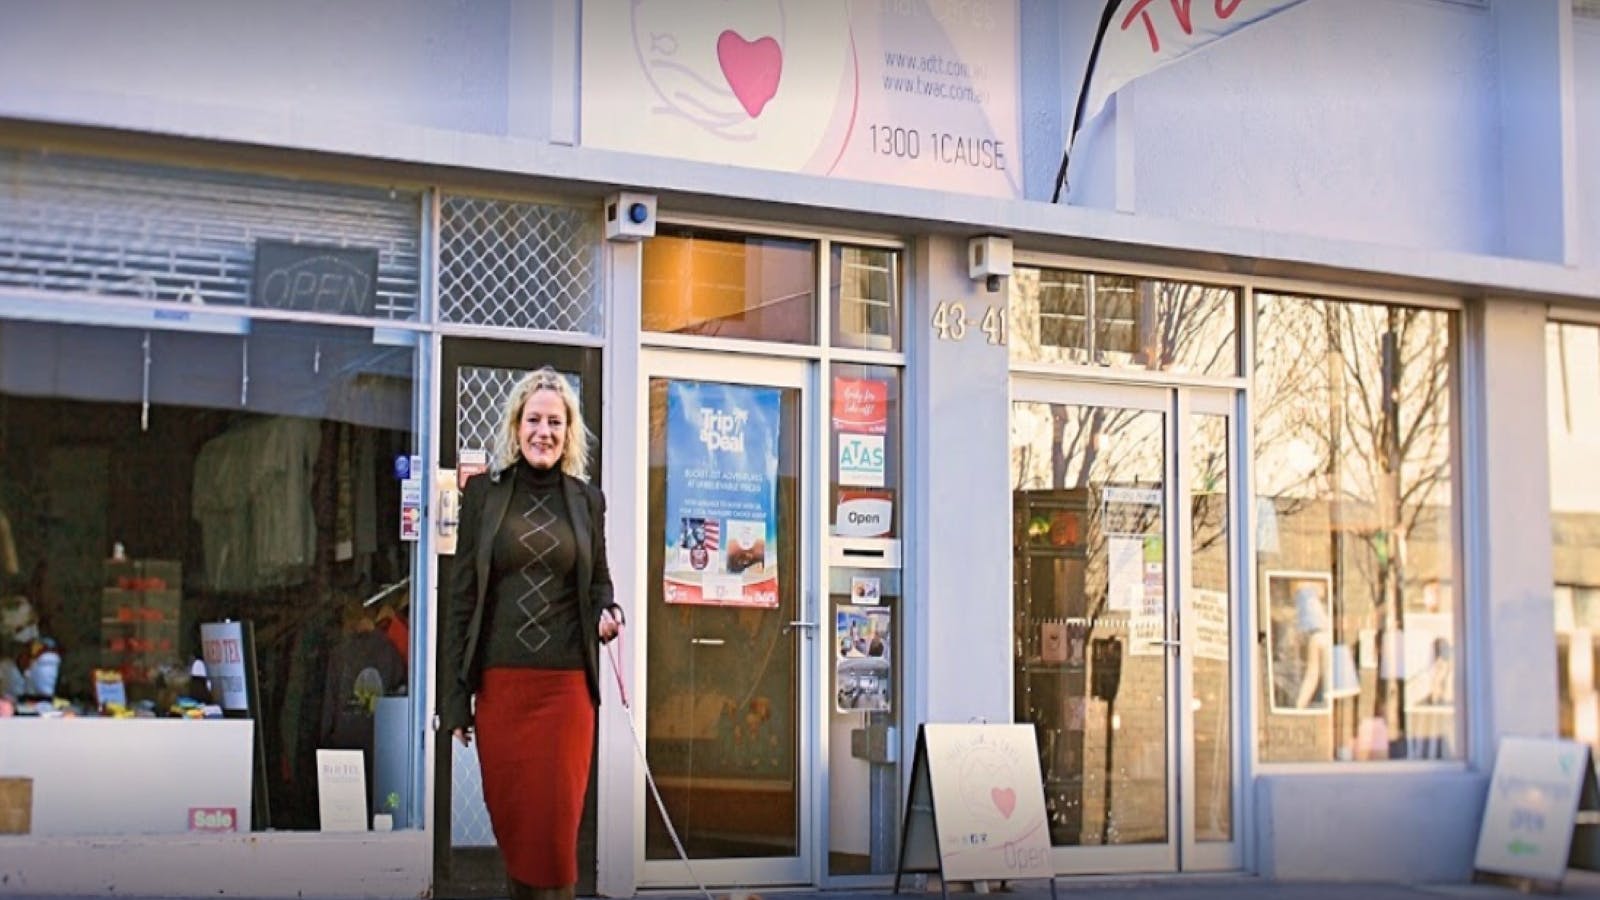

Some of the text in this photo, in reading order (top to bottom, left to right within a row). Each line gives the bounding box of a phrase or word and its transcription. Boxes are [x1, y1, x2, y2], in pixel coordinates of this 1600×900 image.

[869, 124, 1006, 171] 1300 1CAUSE
[263, 269, 371, 315] OPEN
[699, 406, 734, 435] Trip
[707, 431, 745, 453] Deal
[840, 440, 883, 466] ATAS
[847, 511, 881, 527] Open
[194, 810, 232, 828] Sale
[1004, 841, 1050, 872] Open
